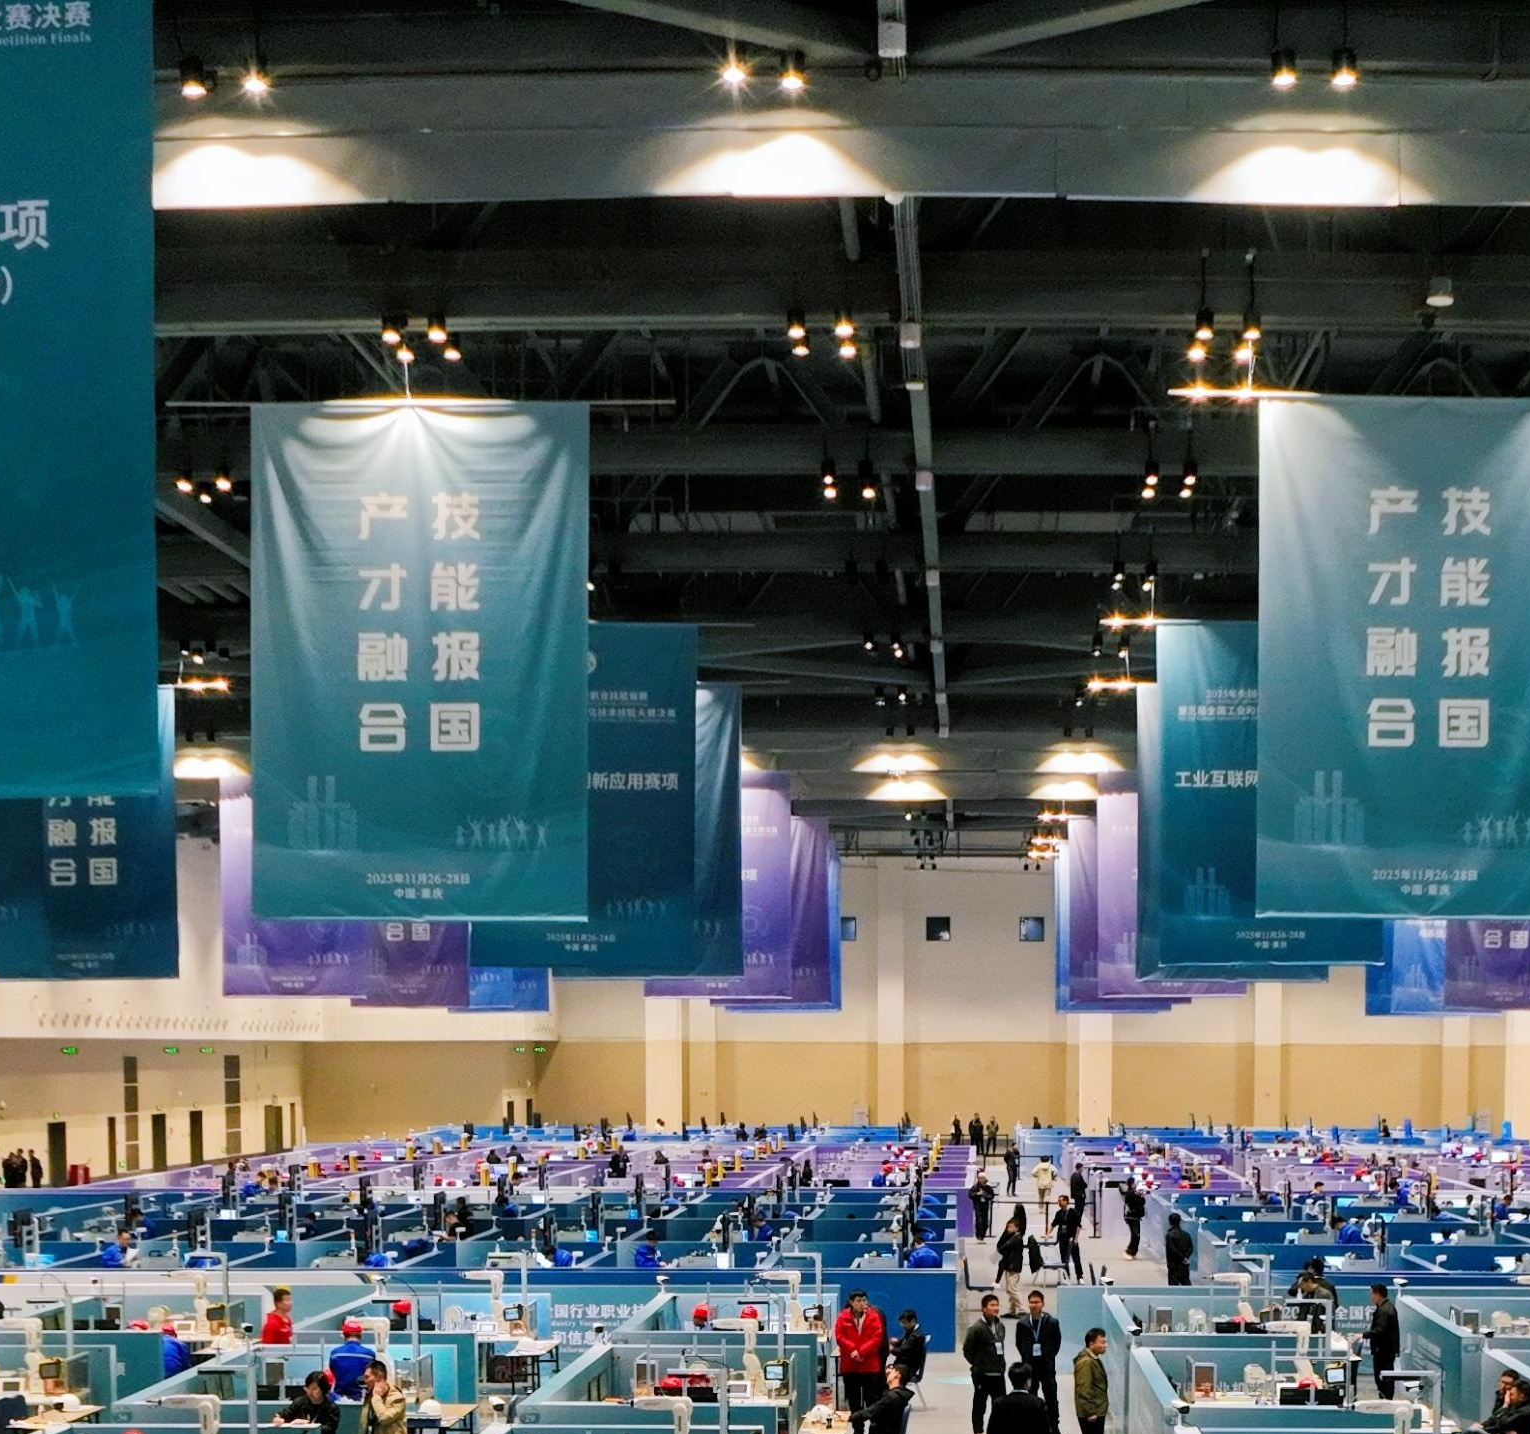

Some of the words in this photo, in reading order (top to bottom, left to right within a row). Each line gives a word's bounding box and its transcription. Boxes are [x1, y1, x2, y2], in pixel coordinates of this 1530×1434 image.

[51, 31, 92, 44] Finals
[357, 491, 408, 753] 产才融合
[430, 491, 481, 752] 技能报国
[1366, 486, 1418, 749] 产才融合
[1439, 486, 1491, 749] 技能报国
[366, 872, 470, 886] 2025年11月26-28日
